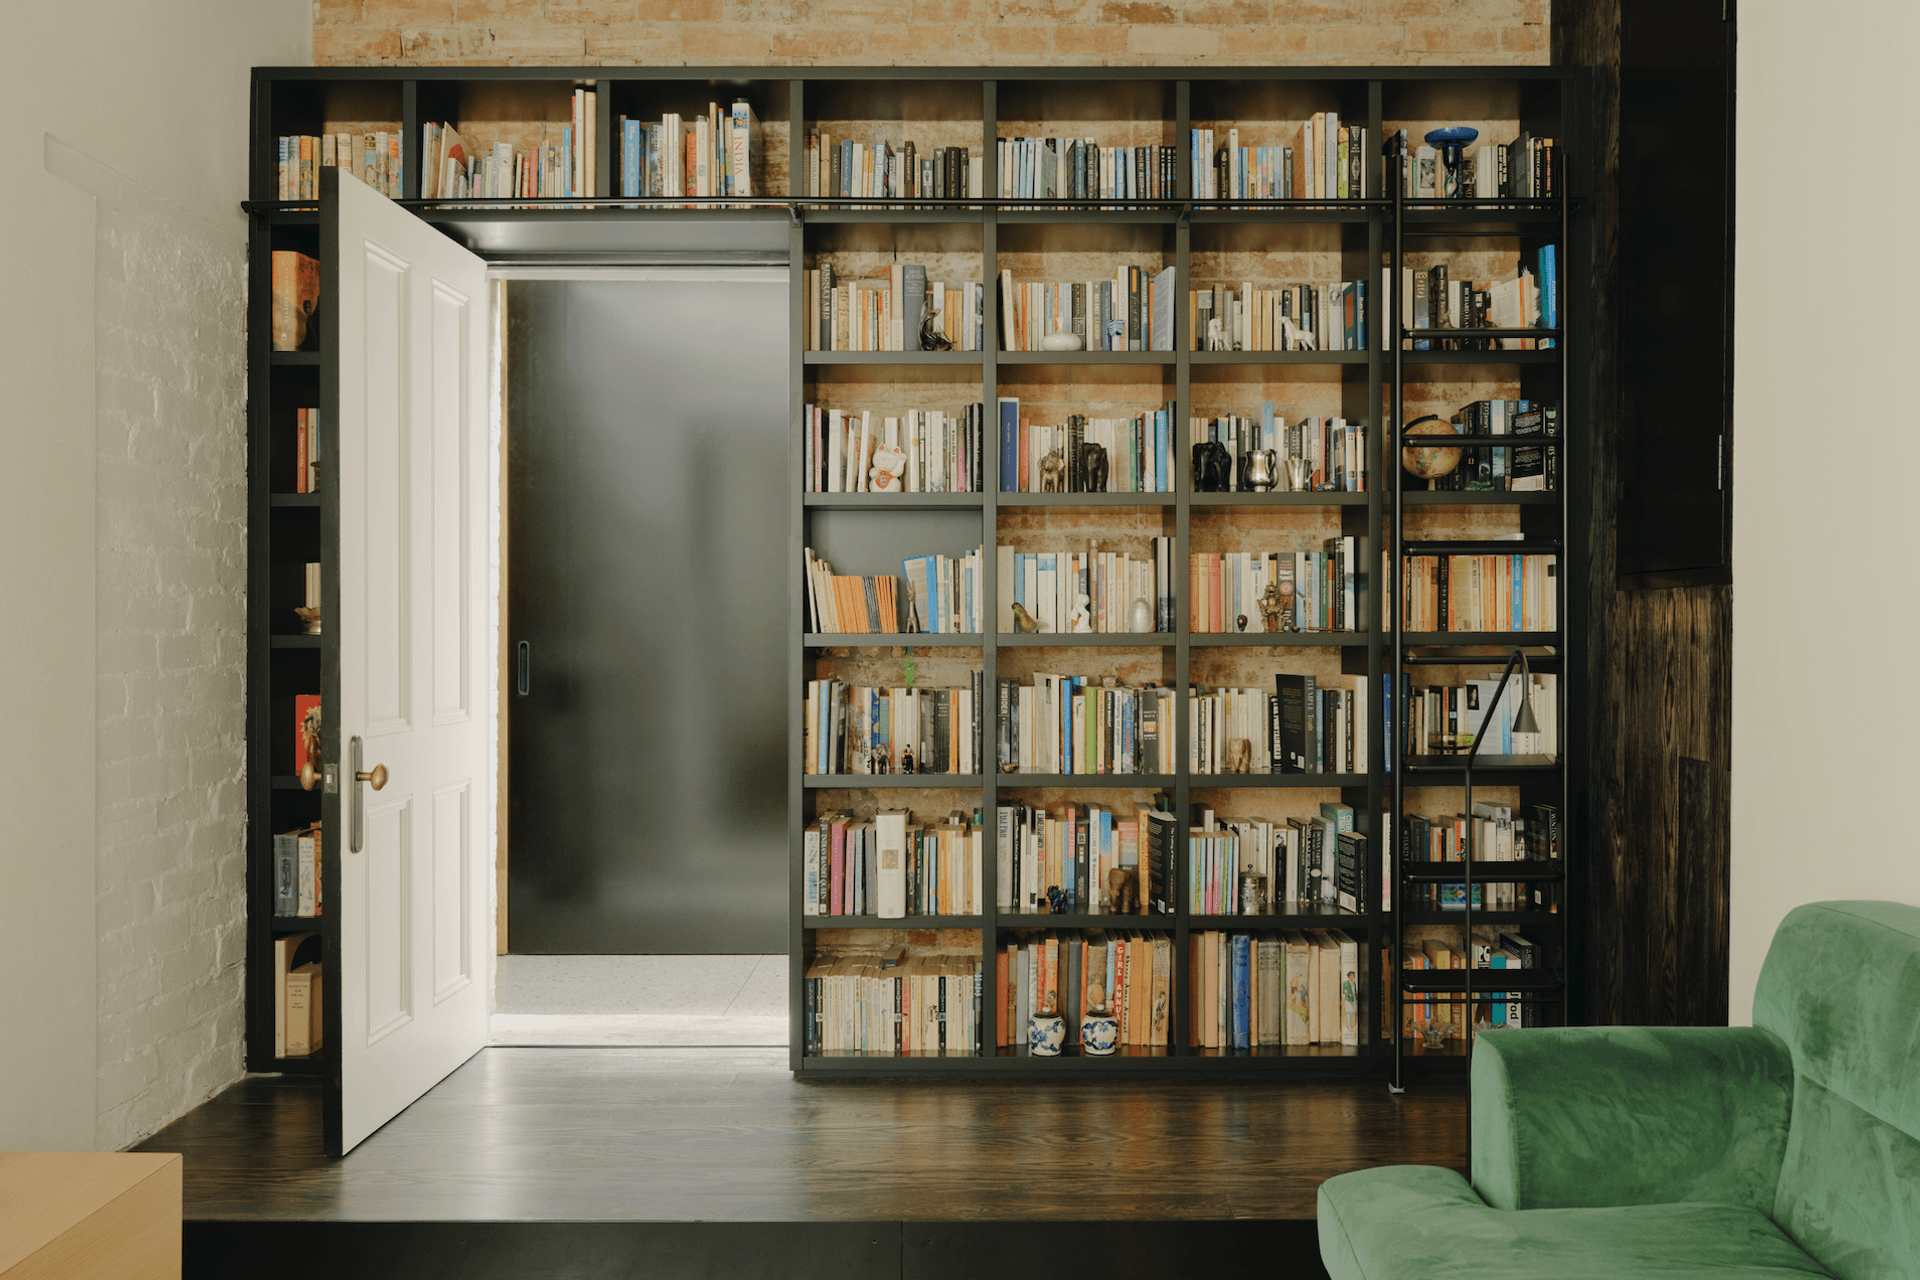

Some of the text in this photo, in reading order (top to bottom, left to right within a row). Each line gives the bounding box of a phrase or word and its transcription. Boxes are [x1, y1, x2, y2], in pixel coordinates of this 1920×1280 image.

[734, 136, 744, 175] INDIA
[1036, 813, 1044, 849] EMERGENCY
[820, 833, 828, 900] INDIA'S BANDIT QUEEN
